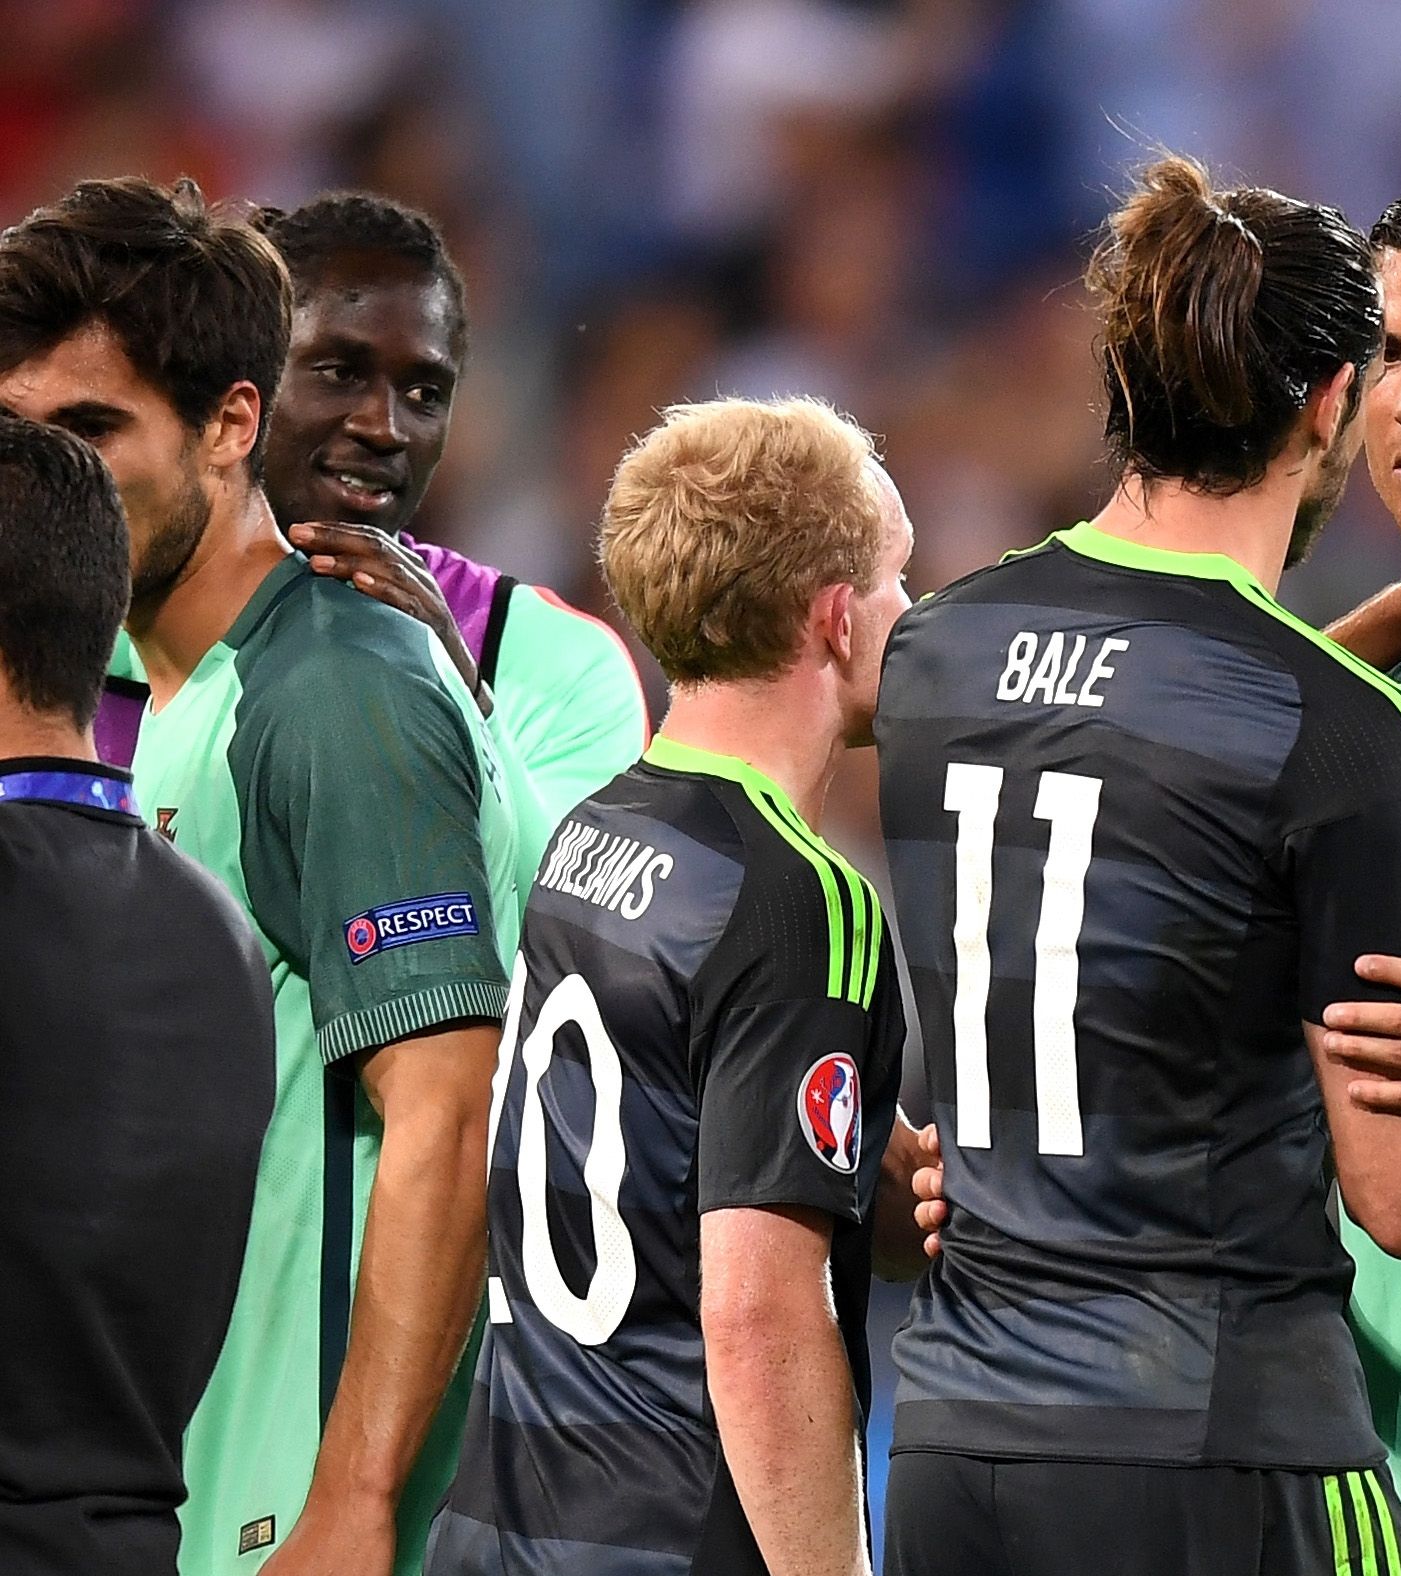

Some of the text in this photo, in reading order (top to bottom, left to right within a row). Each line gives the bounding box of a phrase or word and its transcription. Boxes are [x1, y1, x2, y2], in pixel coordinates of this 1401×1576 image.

[996, 631, 1130, 707] BALE
[539, 819, 675, 921] WILLIAMS
[377, 904, 473, 938] RESPECT
[943, 762, 1103, 1157] 11
